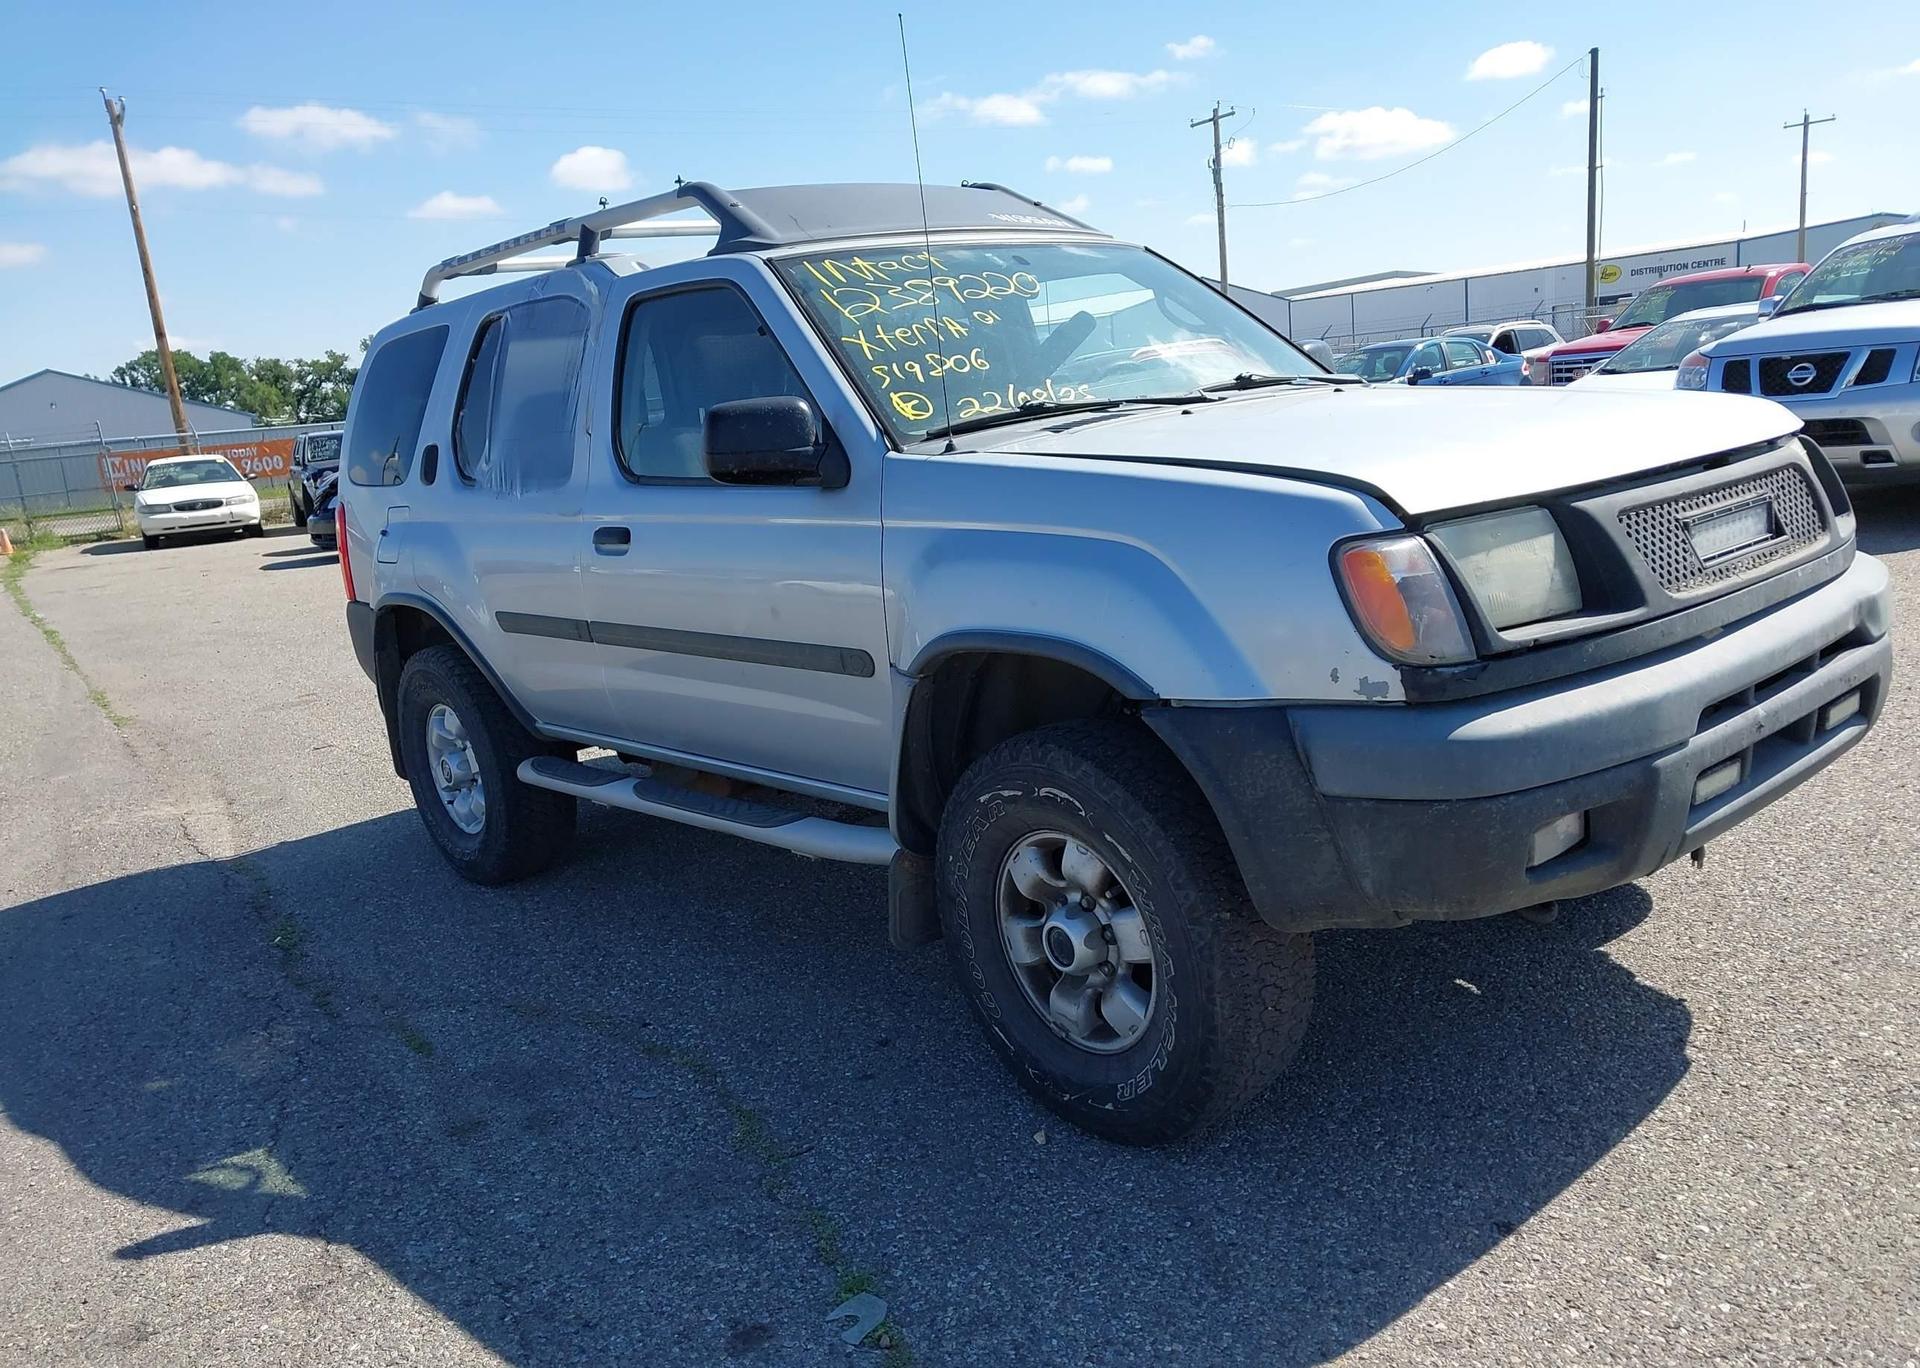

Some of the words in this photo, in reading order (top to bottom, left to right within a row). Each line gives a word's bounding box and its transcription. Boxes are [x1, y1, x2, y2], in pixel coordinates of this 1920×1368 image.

[1630, 262, 1689, 277] DISTRIBUTION
[1691, 257, 1727, 269] CENTRE
[954, 799, 1006, 1019] GOODYEAR
[1117, 869, 1178, 1101] WRANGLER
